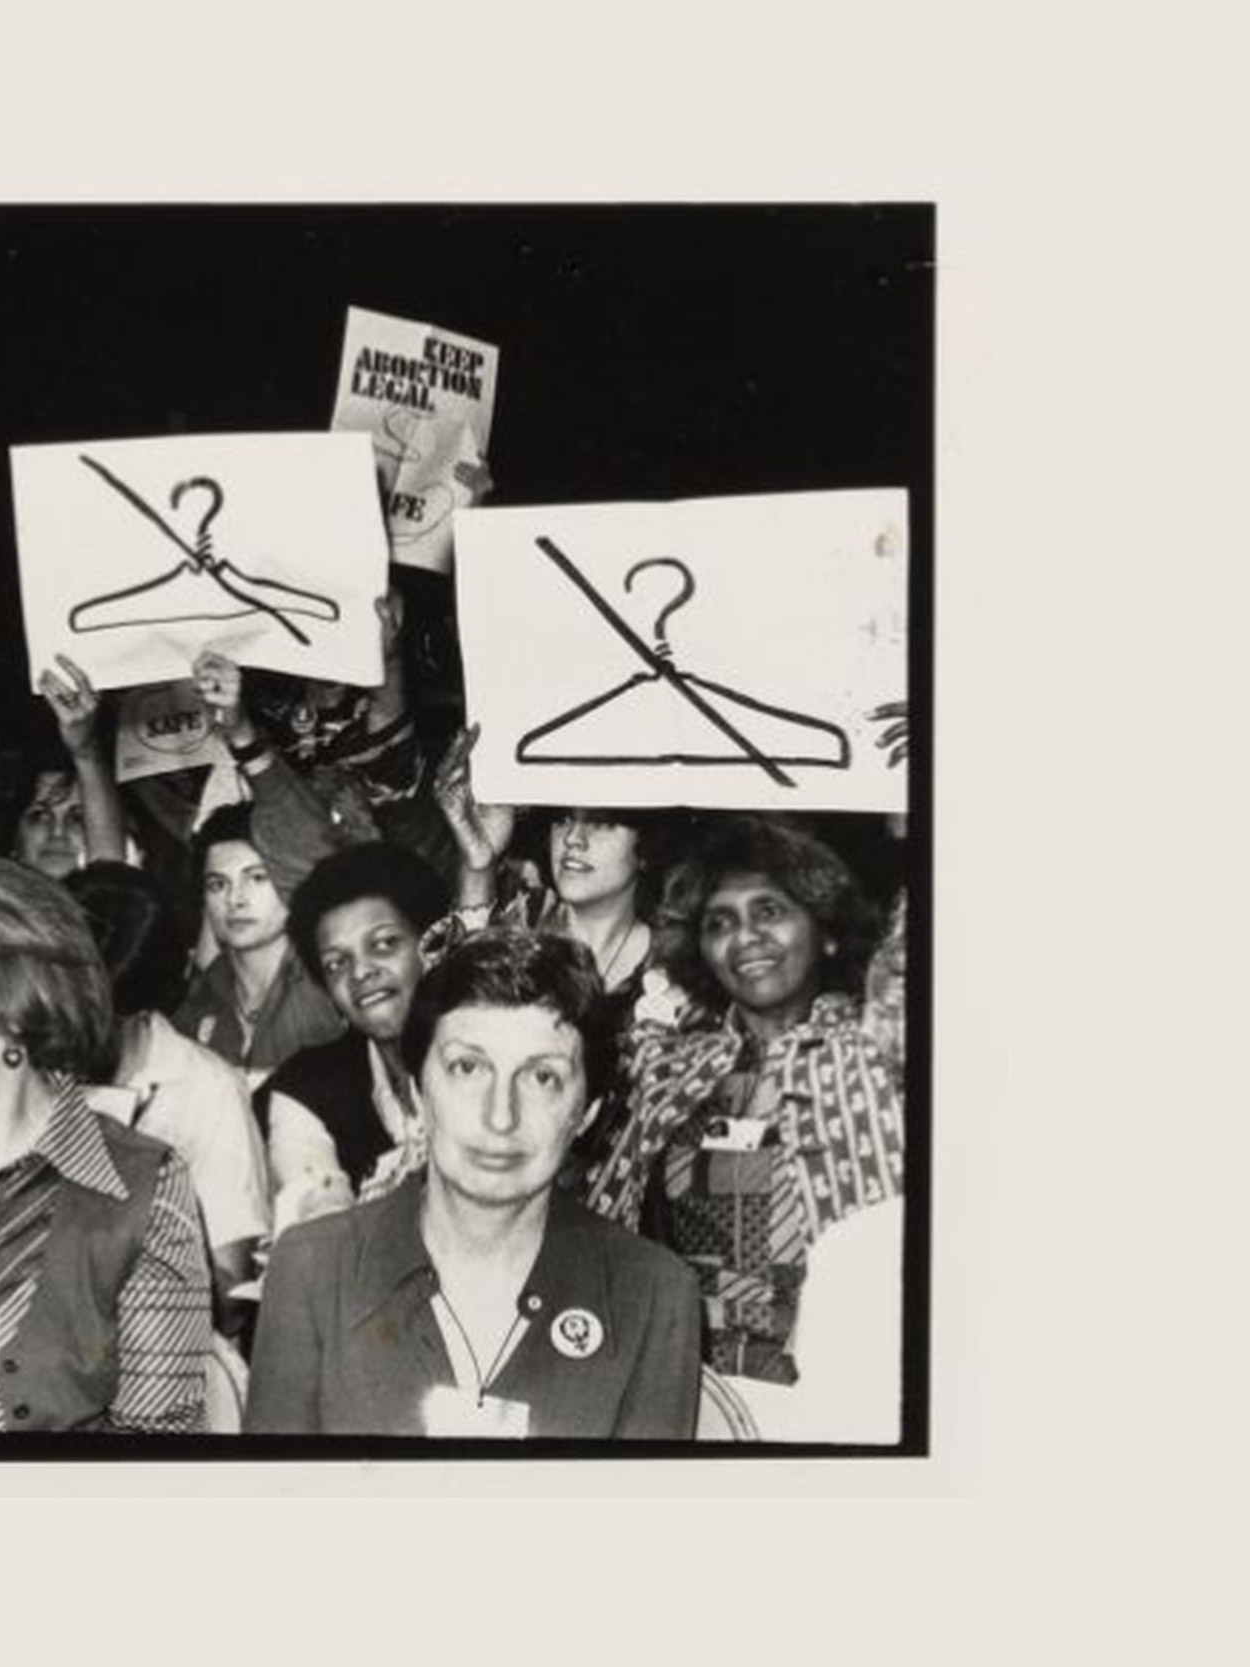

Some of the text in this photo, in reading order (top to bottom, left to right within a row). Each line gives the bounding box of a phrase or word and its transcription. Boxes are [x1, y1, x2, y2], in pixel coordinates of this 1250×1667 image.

[422, 336, 485, 371] KEEP
[352, 346, 483, 401] ABORTION
[351, 371, 435, 412] LEGAL
[390, 491, 427, 522] FE
[147, 709, 203, 738] SAFE
